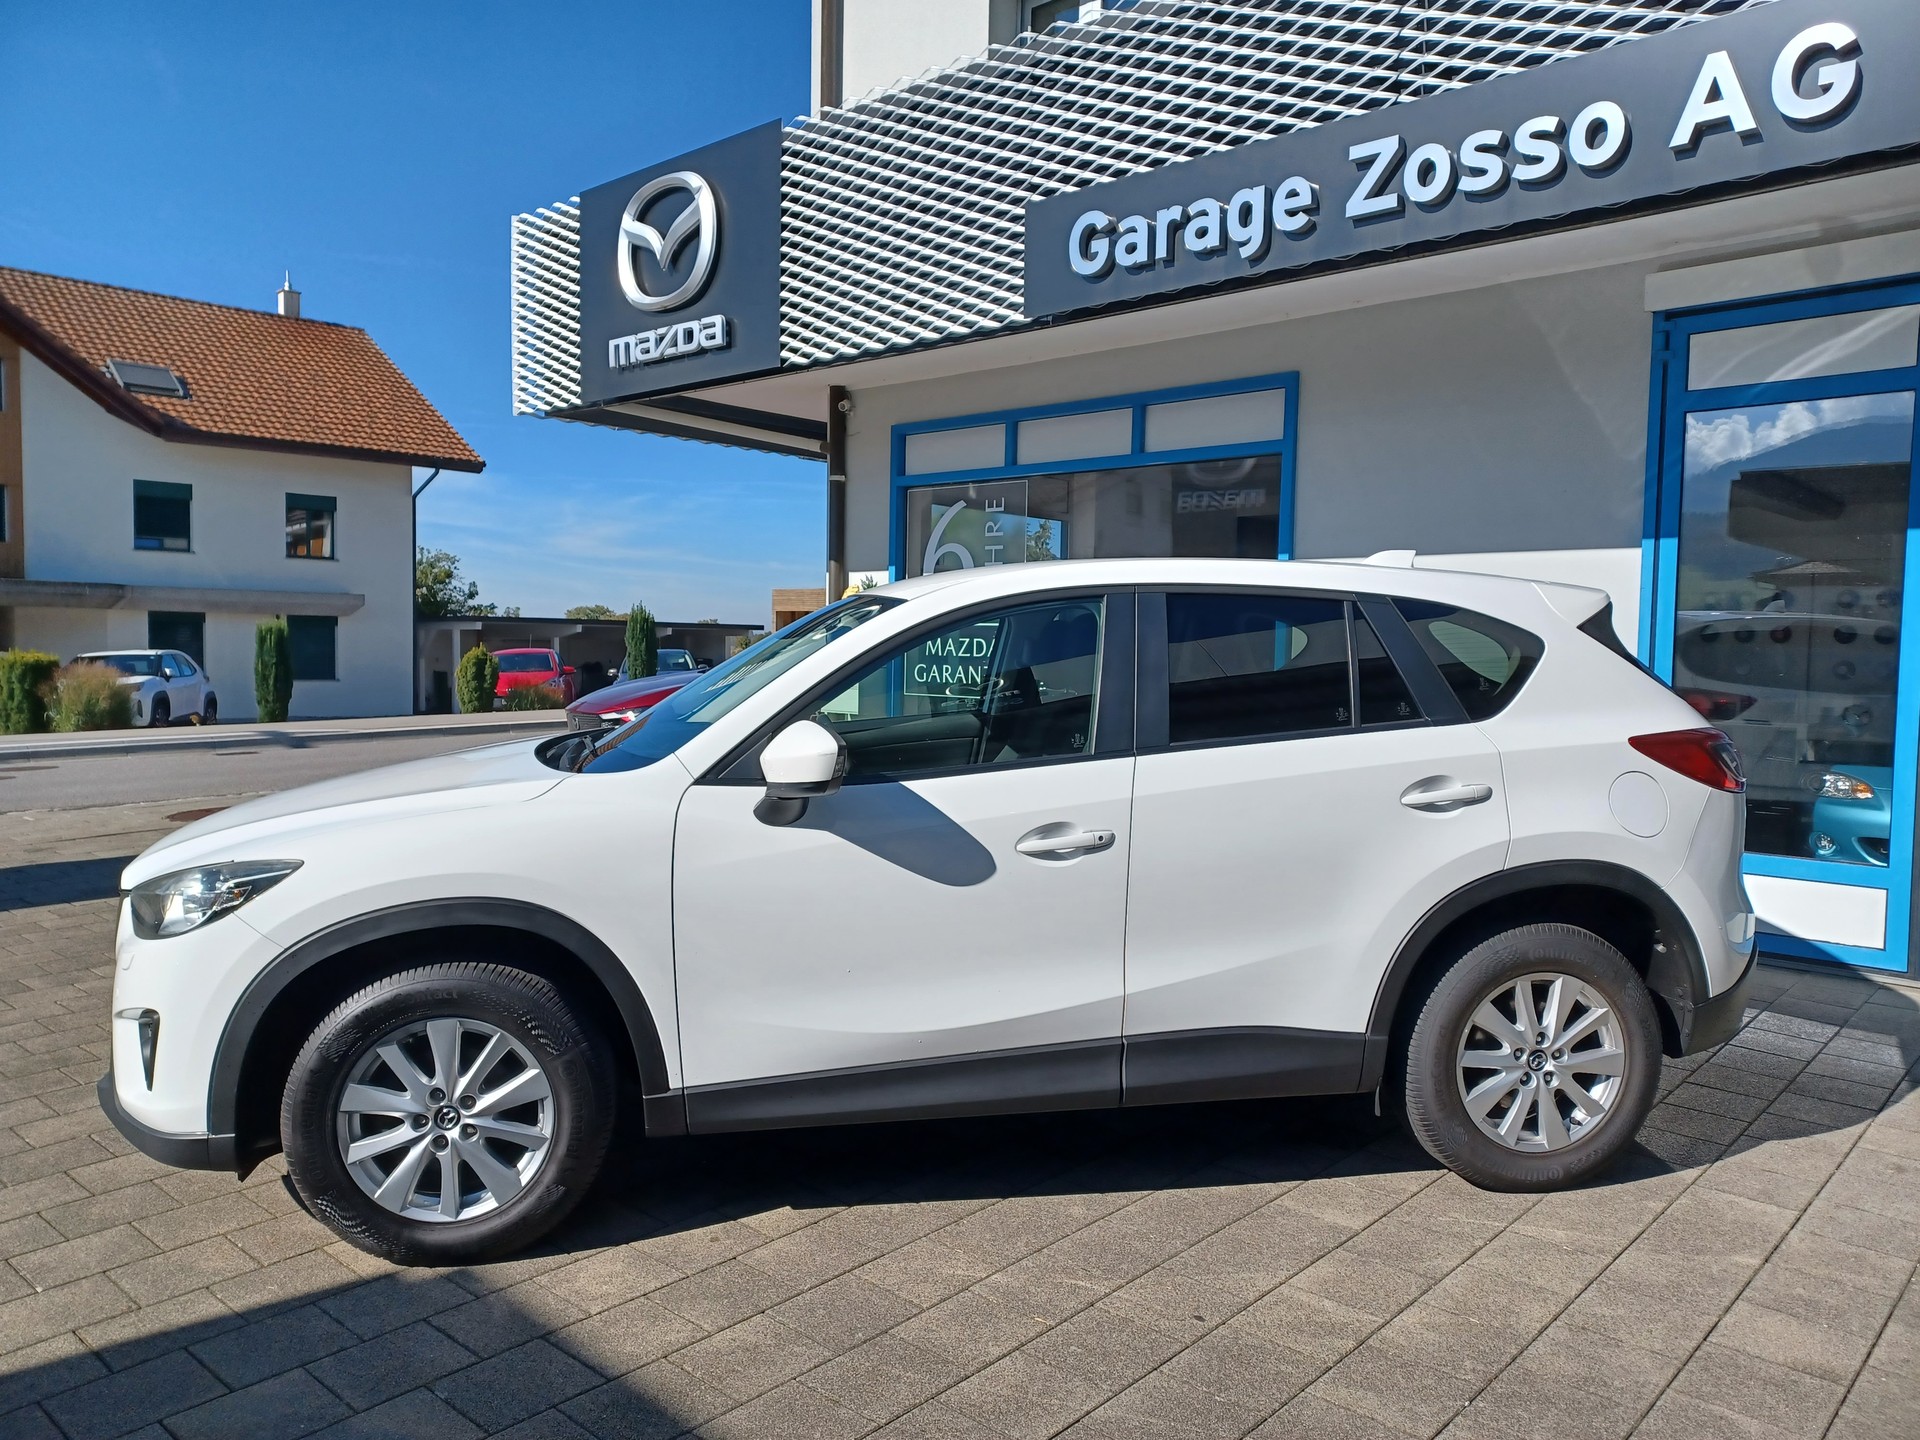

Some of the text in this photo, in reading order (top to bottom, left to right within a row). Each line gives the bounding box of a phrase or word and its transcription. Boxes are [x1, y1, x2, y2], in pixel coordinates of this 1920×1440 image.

[1069, 22, 1861, 276] Garage Zosso AG
[608, 314, 727, 369] mazda
[923, 500, 975, 576] 6
